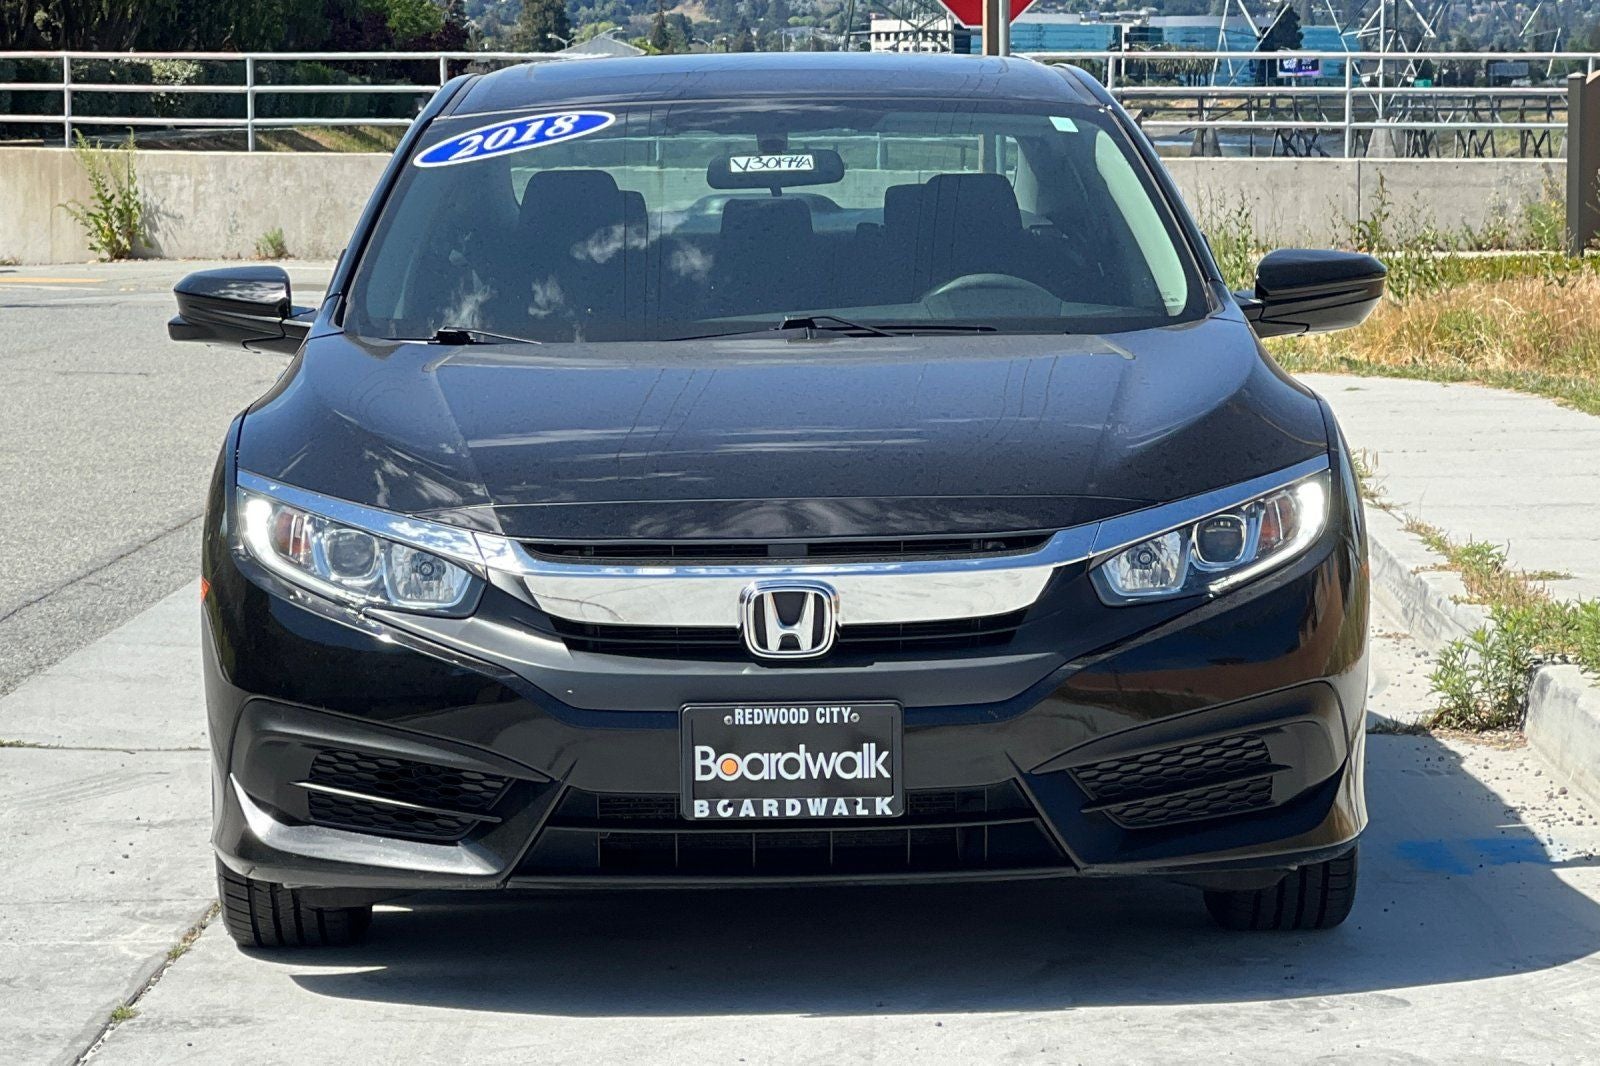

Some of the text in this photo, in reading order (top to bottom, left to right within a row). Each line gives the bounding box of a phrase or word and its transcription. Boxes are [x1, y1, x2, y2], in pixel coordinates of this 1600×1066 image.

[448, 114, 580, 161] 2018
[734, 707, 851, 725] REDWOOD CITY
[694, 742, 891, 782] Boardwalk
[694, 798, 893, 818] BOARDWALK
